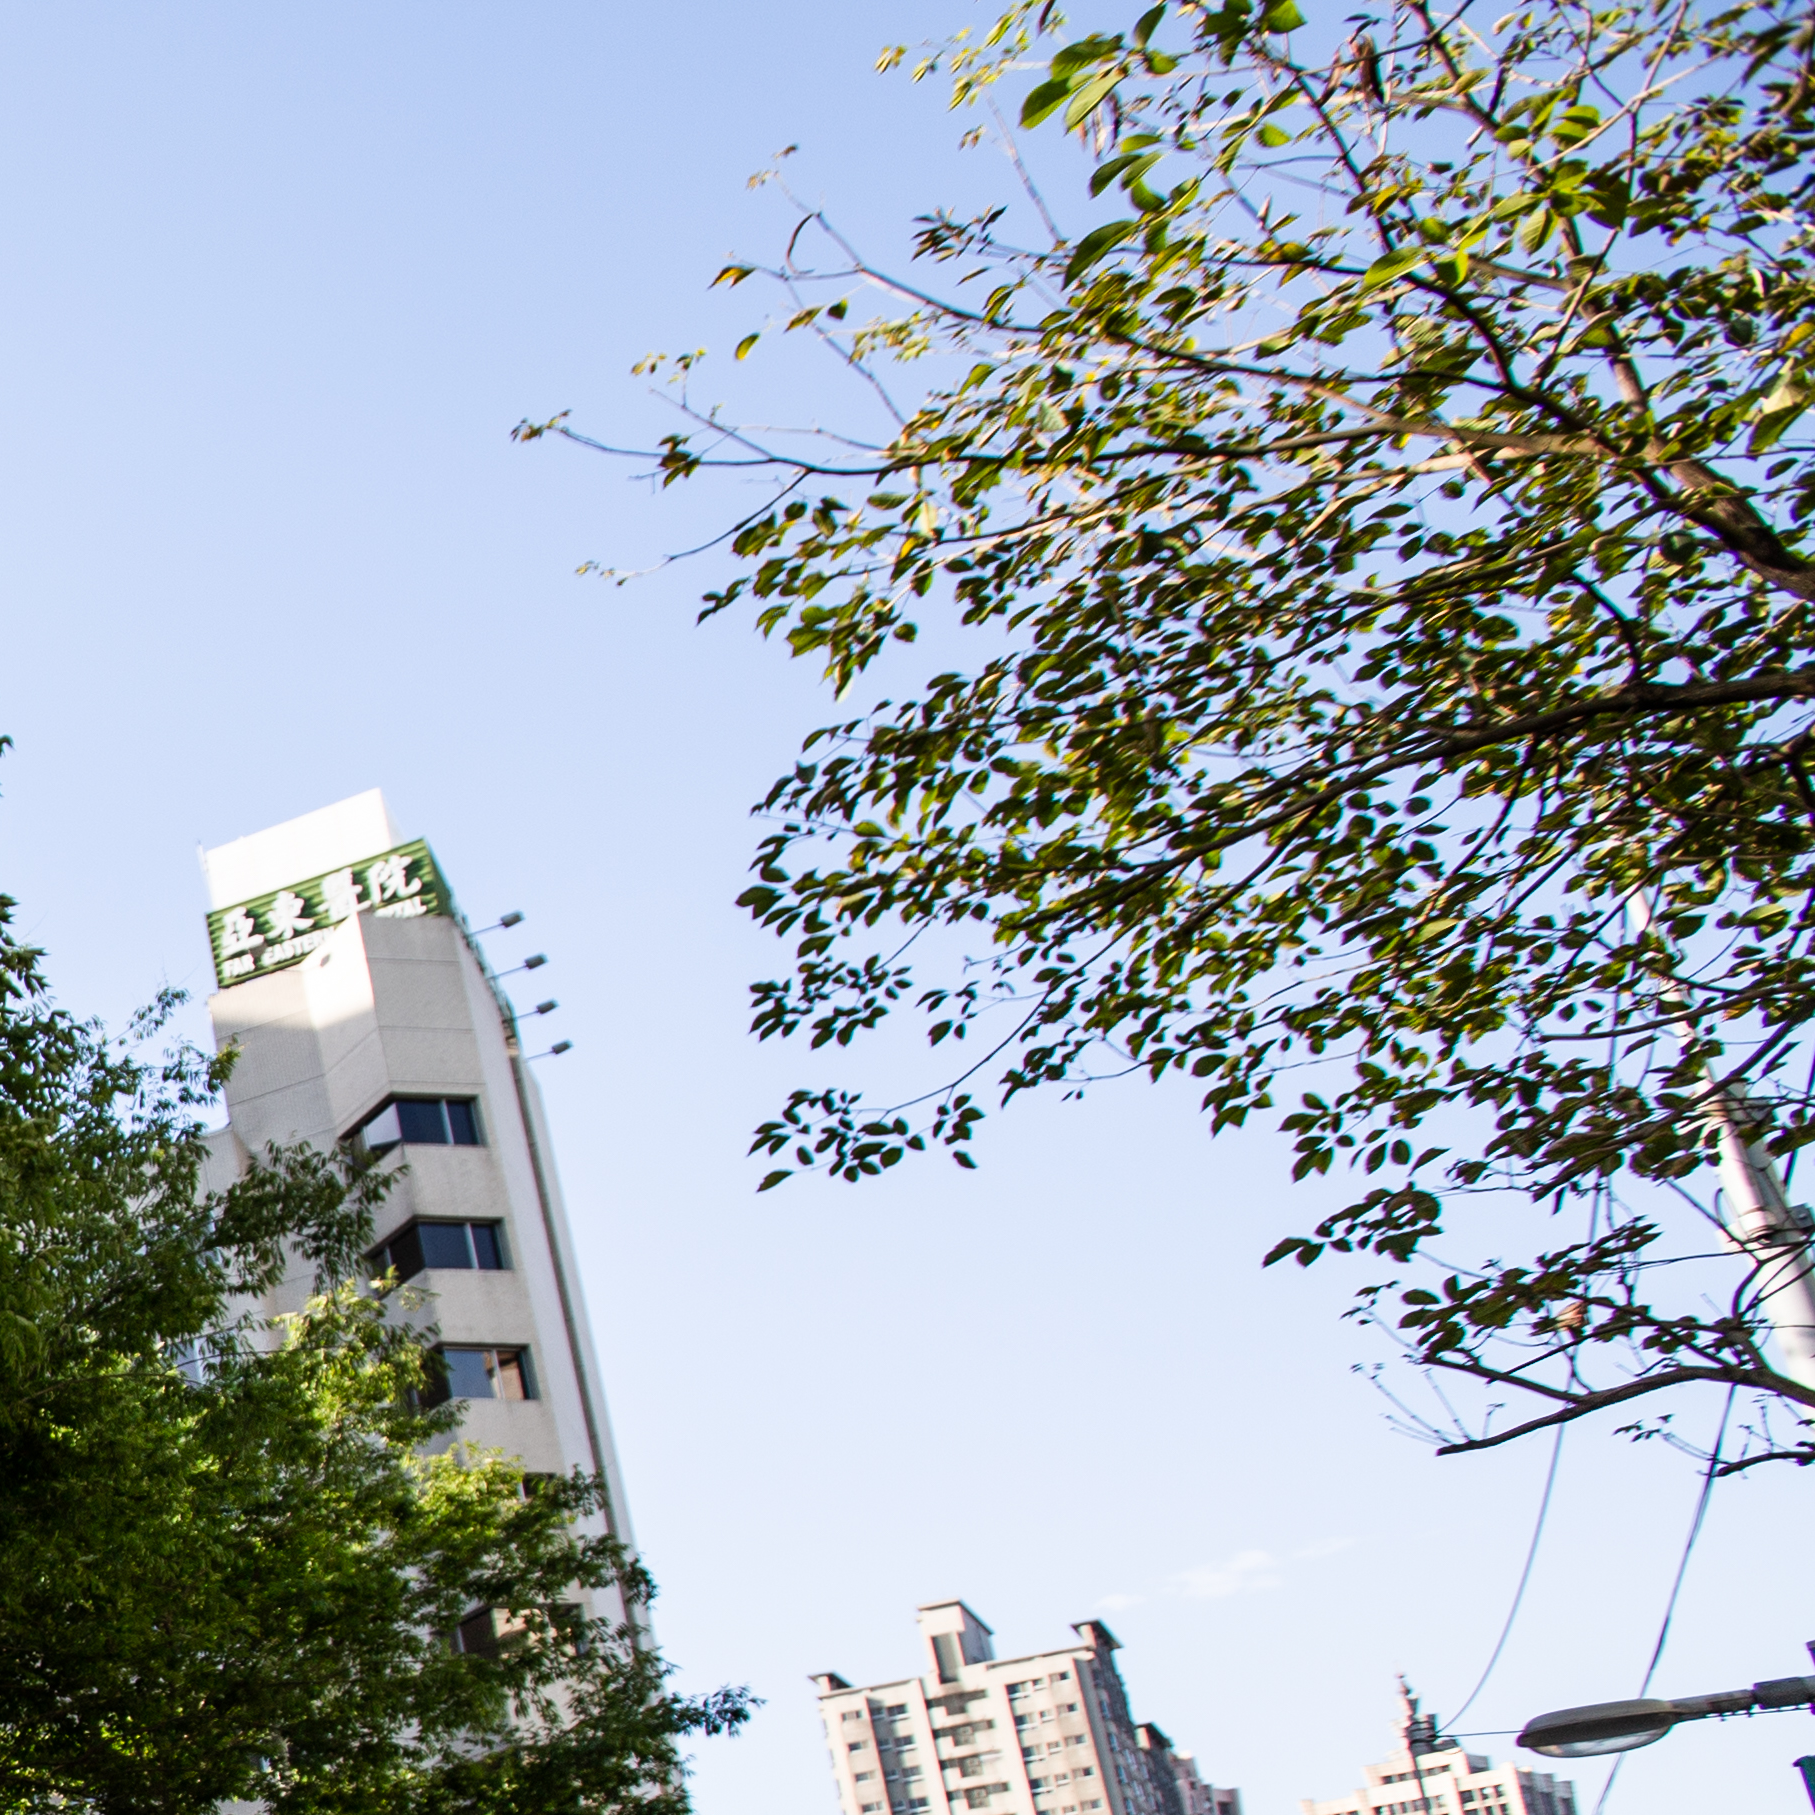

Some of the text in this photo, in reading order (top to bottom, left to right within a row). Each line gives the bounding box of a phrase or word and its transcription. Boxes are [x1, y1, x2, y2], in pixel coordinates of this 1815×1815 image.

[219, 854, 423, 957] 亞東醫院
[222, 953, 256, 979] FAR
